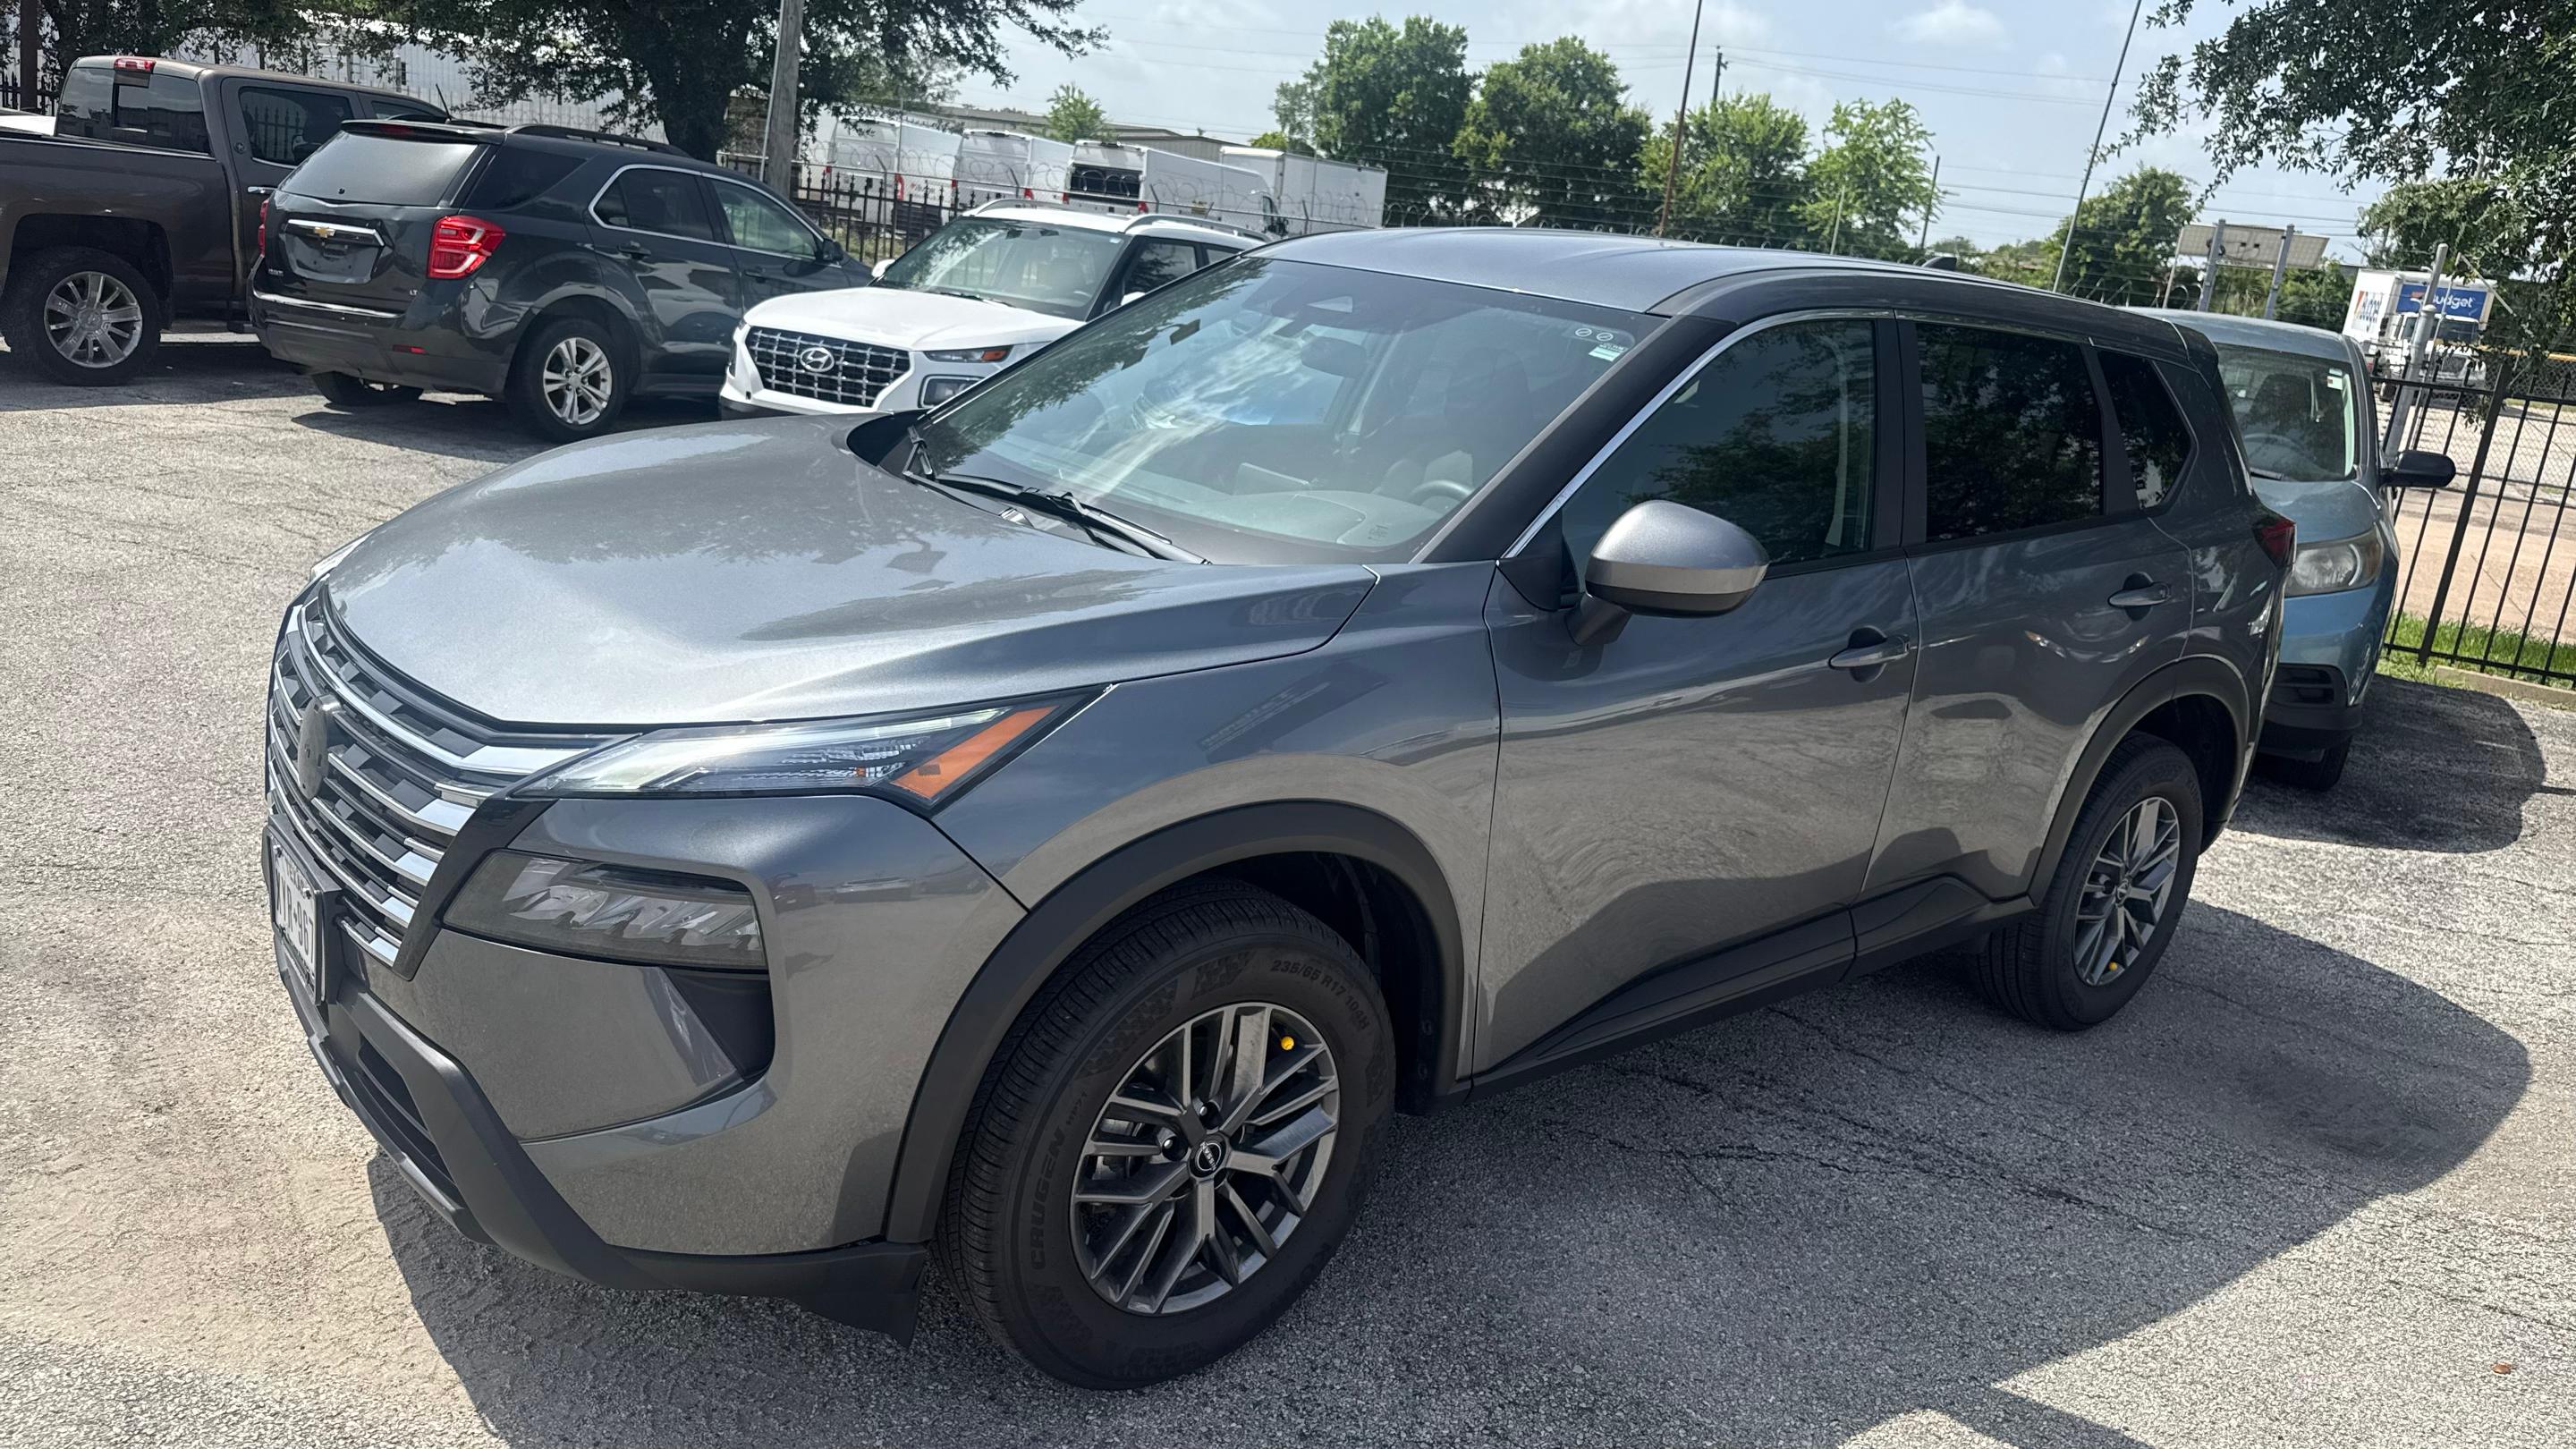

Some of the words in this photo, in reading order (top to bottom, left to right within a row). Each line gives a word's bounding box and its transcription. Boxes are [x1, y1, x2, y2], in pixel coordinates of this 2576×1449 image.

[2433, 293, 2474, 309] udget
[1270, 959, 1322, 981] 235/65
[1321, 974, 1346, 996] R17
[1030, 1126, 1066, 1270] CRUGEN
